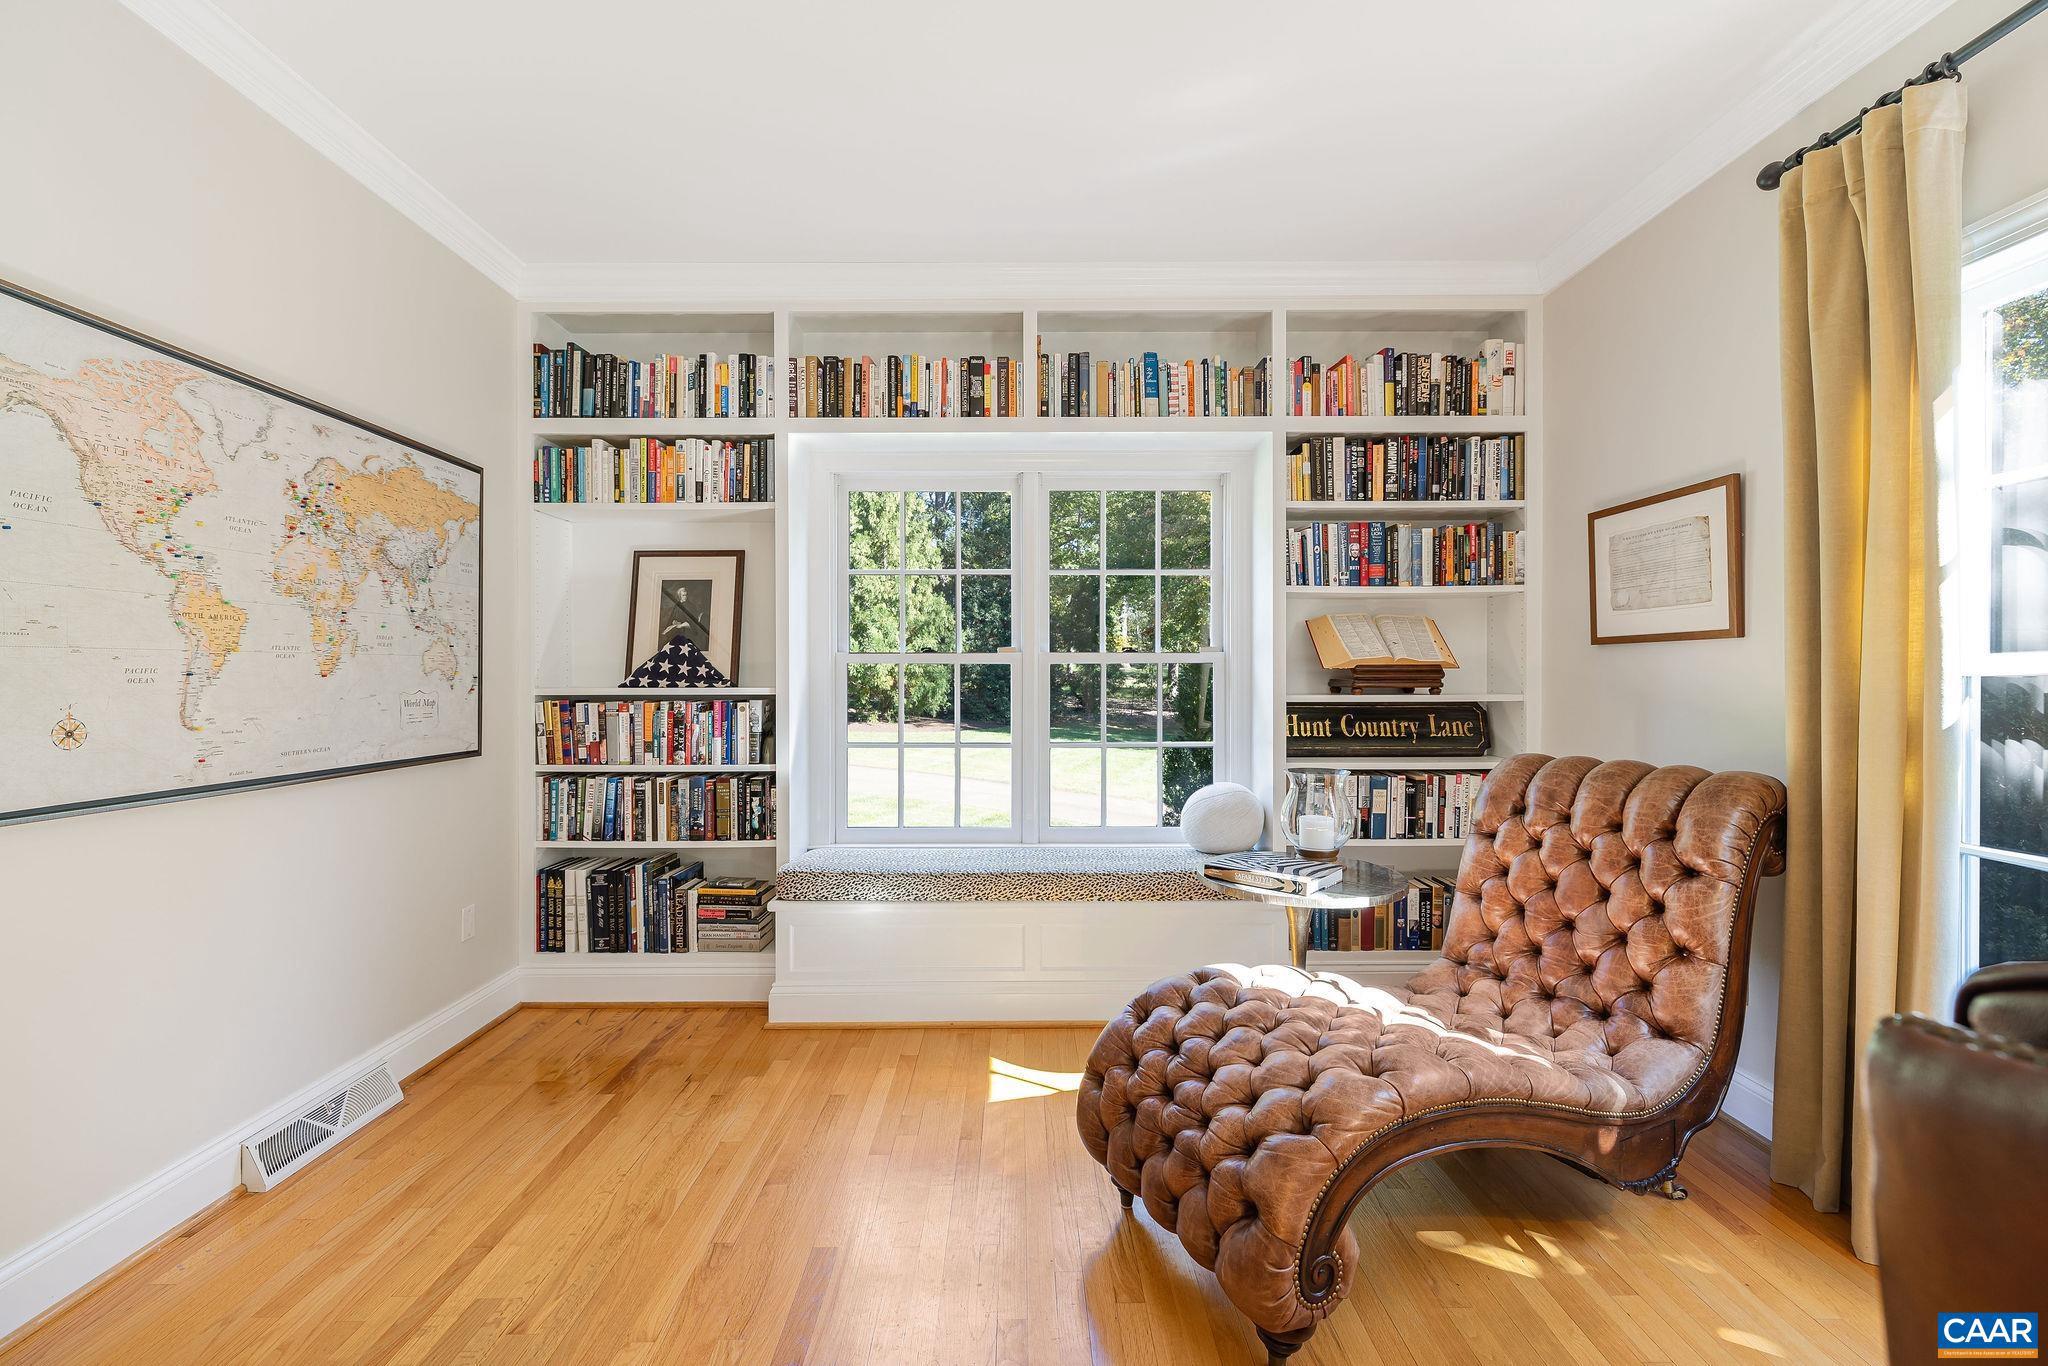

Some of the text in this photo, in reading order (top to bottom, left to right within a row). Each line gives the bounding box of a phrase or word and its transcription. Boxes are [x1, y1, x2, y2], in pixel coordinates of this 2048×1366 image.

[1388, 442, 1397, 473] COMPANY
[1286, 714, 1474, 744] Hunt Country Lane
